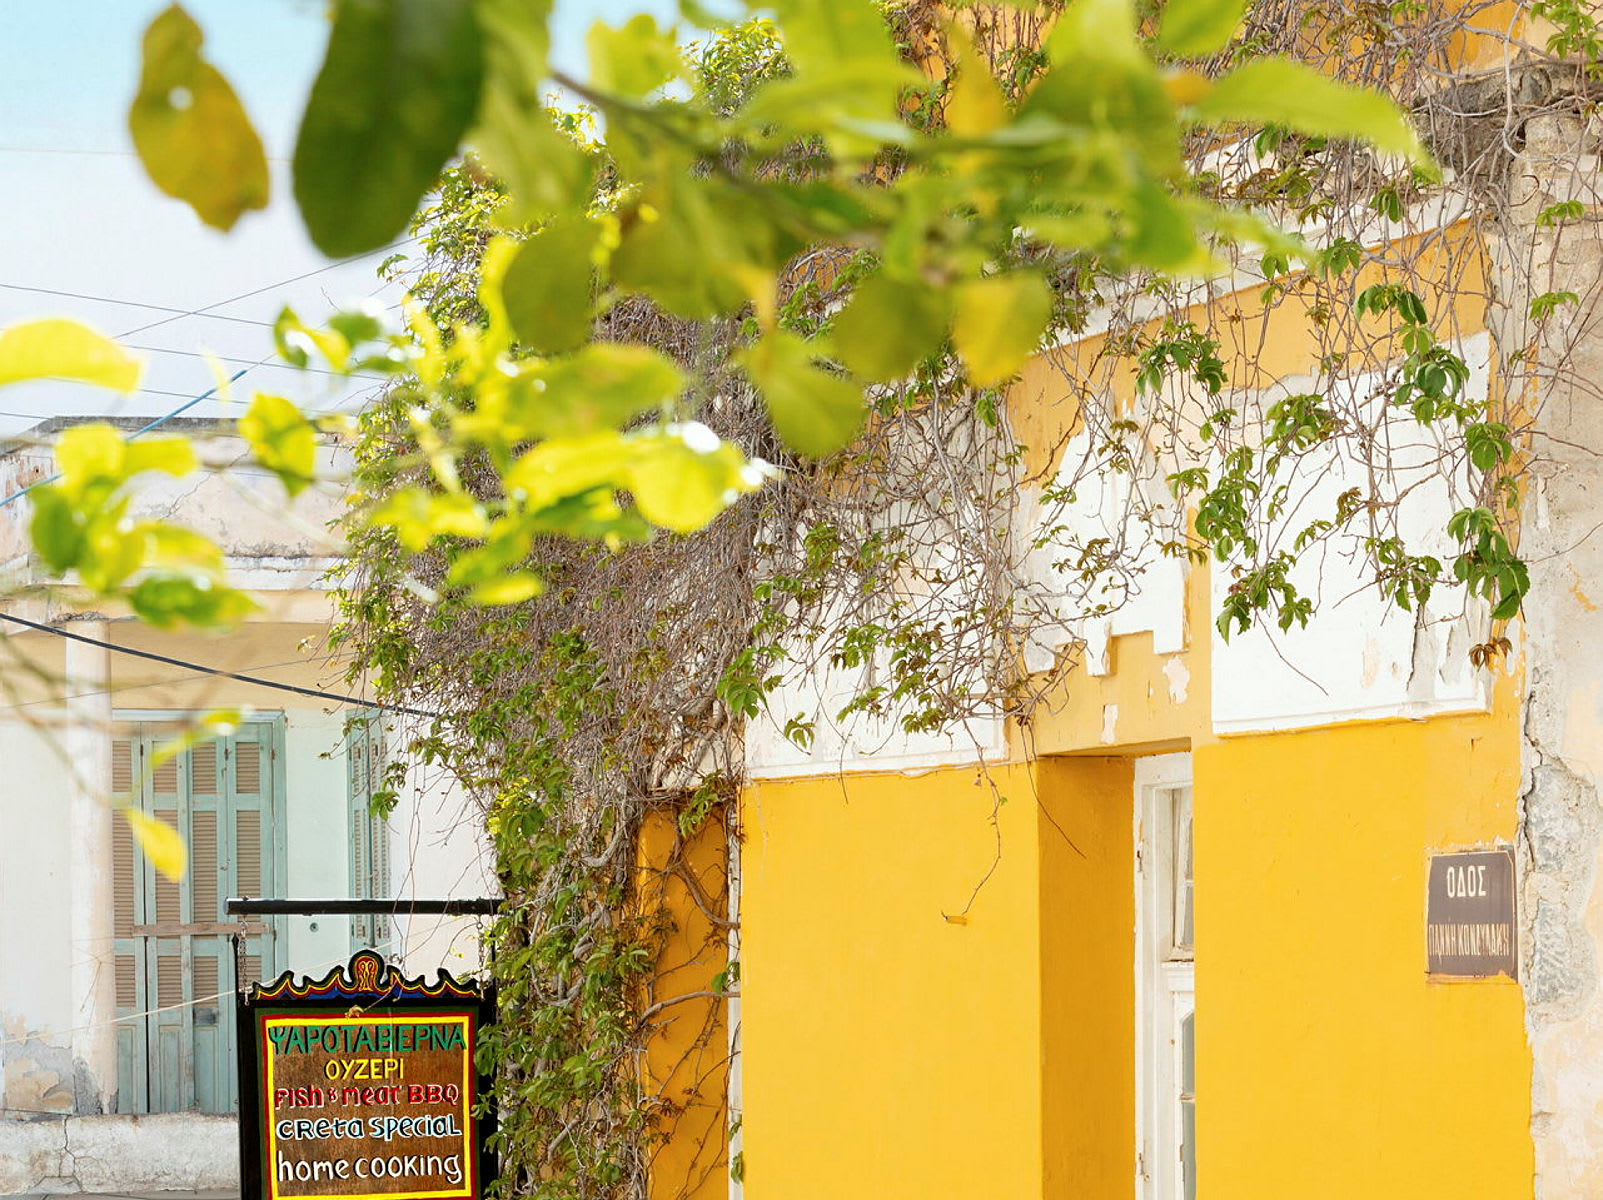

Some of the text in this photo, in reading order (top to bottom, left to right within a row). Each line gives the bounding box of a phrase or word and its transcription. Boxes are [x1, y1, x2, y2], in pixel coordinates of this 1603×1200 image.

[1447, 865, 1487, 898] ΟΔΟΣ
[268, 1025, 467, 1054] ΨΑΡΟΤΑΒΕΡΝΑ
[324, 1058, 404, 1080] ΟΥΖΕΡΙ
[408, 1084, 459, 1107] BBQ
